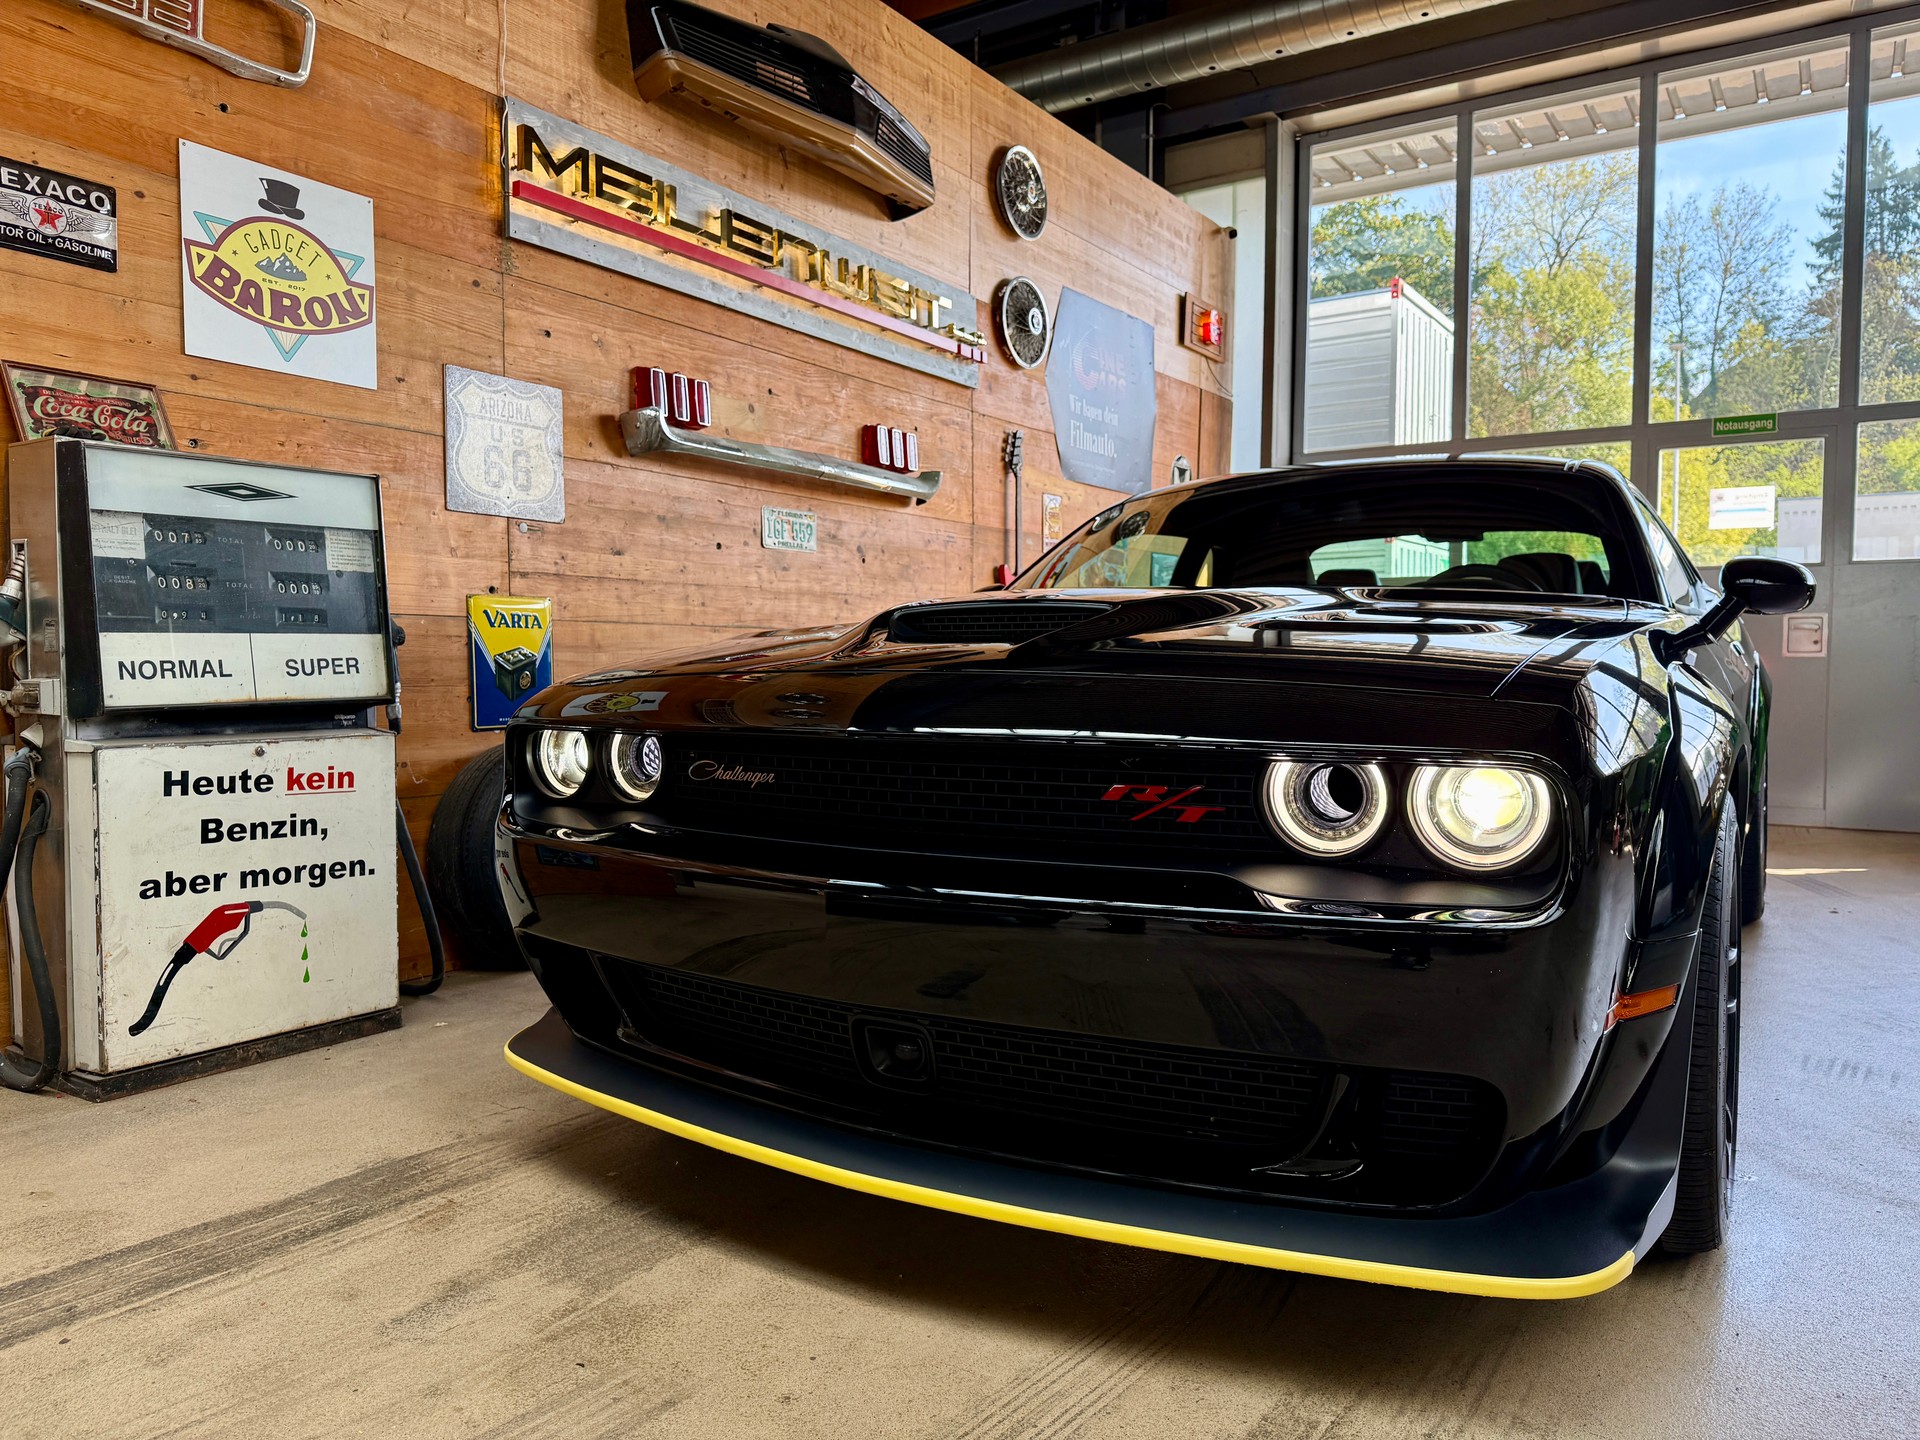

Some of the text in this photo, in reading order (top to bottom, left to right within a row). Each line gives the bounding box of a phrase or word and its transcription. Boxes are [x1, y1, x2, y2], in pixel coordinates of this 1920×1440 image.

[27, 229, 46, 244] OIL
[55, 238, 114, 261] GASOLINE
[243, 228, 322, 268] GADGET
[197, 253, 367, 328] BARON
[262, 277, 306, 292] EST. 2017
[478, 397, 532, 423] ARIZONA
[1716, 419, 1773, 431] Notausgang
[483, 445, 532, 492] 66
[217, 536, 244, 545] TOTAL
[482, 608, 543, 630] VARTA
[117, 658, 233, 681] NORMAL
[284, 656, 361, 678] SUPER
[162, 765, 355, 798] Heute kein
[688, 759, 775, 789] Challenger
[1100, 784, 1227, 823] R/T
[200, 812, 329, 845] Benzin,
[138, 857, 376, 900] aber morgen.
